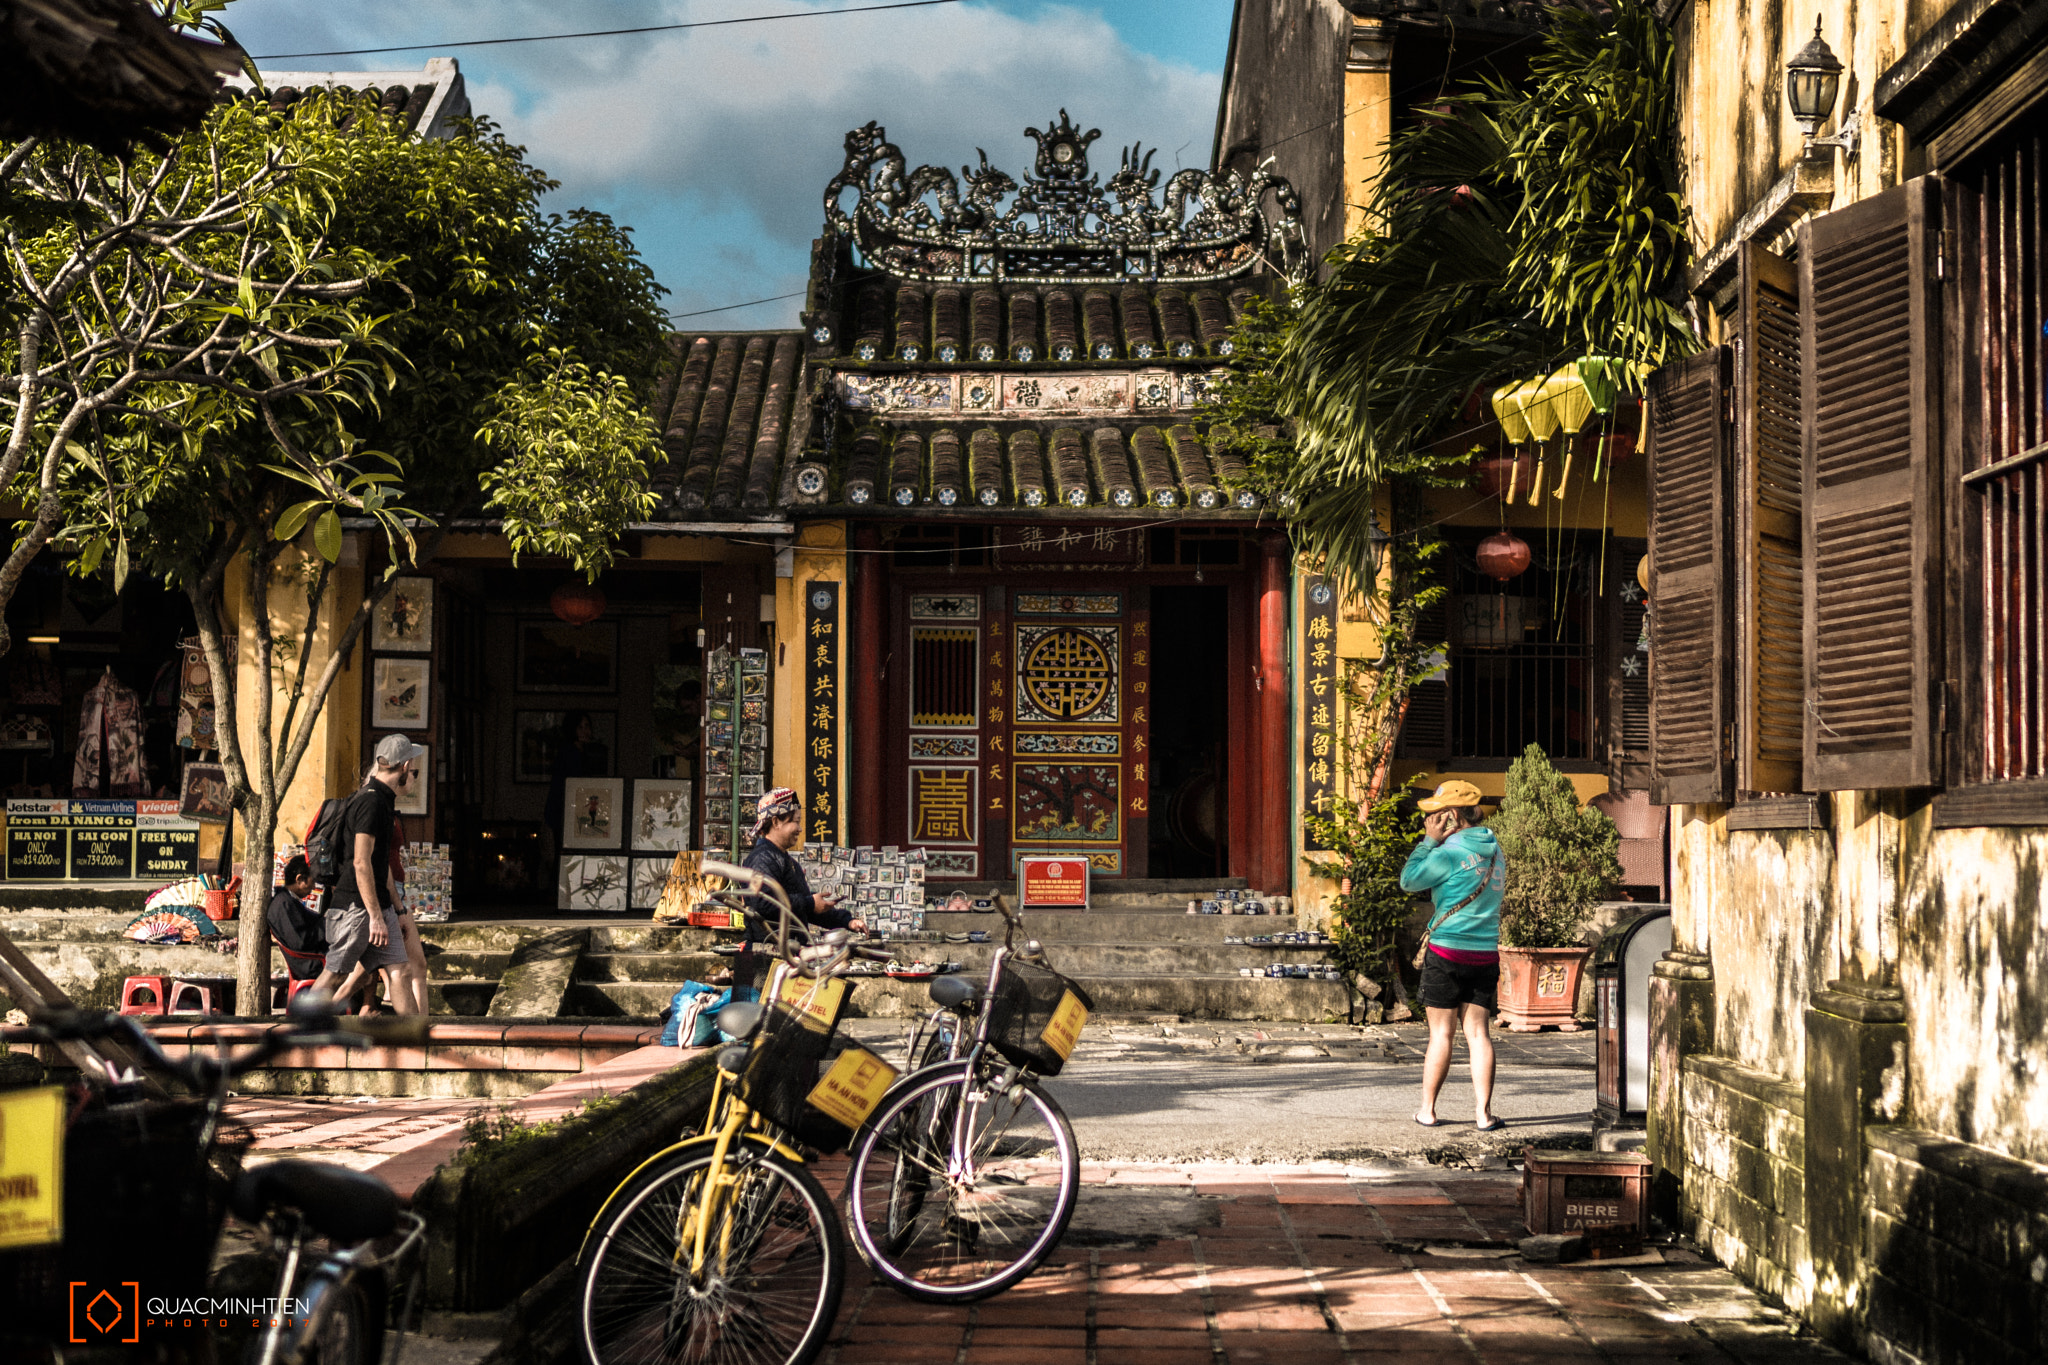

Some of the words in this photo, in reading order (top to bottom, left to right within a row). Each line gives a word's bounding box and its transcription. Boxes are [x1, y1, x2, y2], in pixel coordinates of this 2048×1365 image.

[8, 803, 51, 812] Jetstar
[9, 816, 47, 825] from
[50, 816, 70, 825] DA
[73, 816, 115, 825] NANG
[118, 816, 133, 825] to
[14, 832, 31, 840] HA
[34, 832, 57, 840] NOI
[77, 832, 98, 841] SAI
[101, 832, 128, 841] GON
[141, 832, 166, 842] FREE
[169, 832, 195, 843] TOUR
[27, 842, 47, 853] ONLY
[91, 842, 110, 854] ONLY
[159, 846, 173, 856] ON
[147, 860, 188, 870] SUNDAY
[1538, 965, 1564, 993] 福
[1566, 1204, 1619, 1217] BIERE
